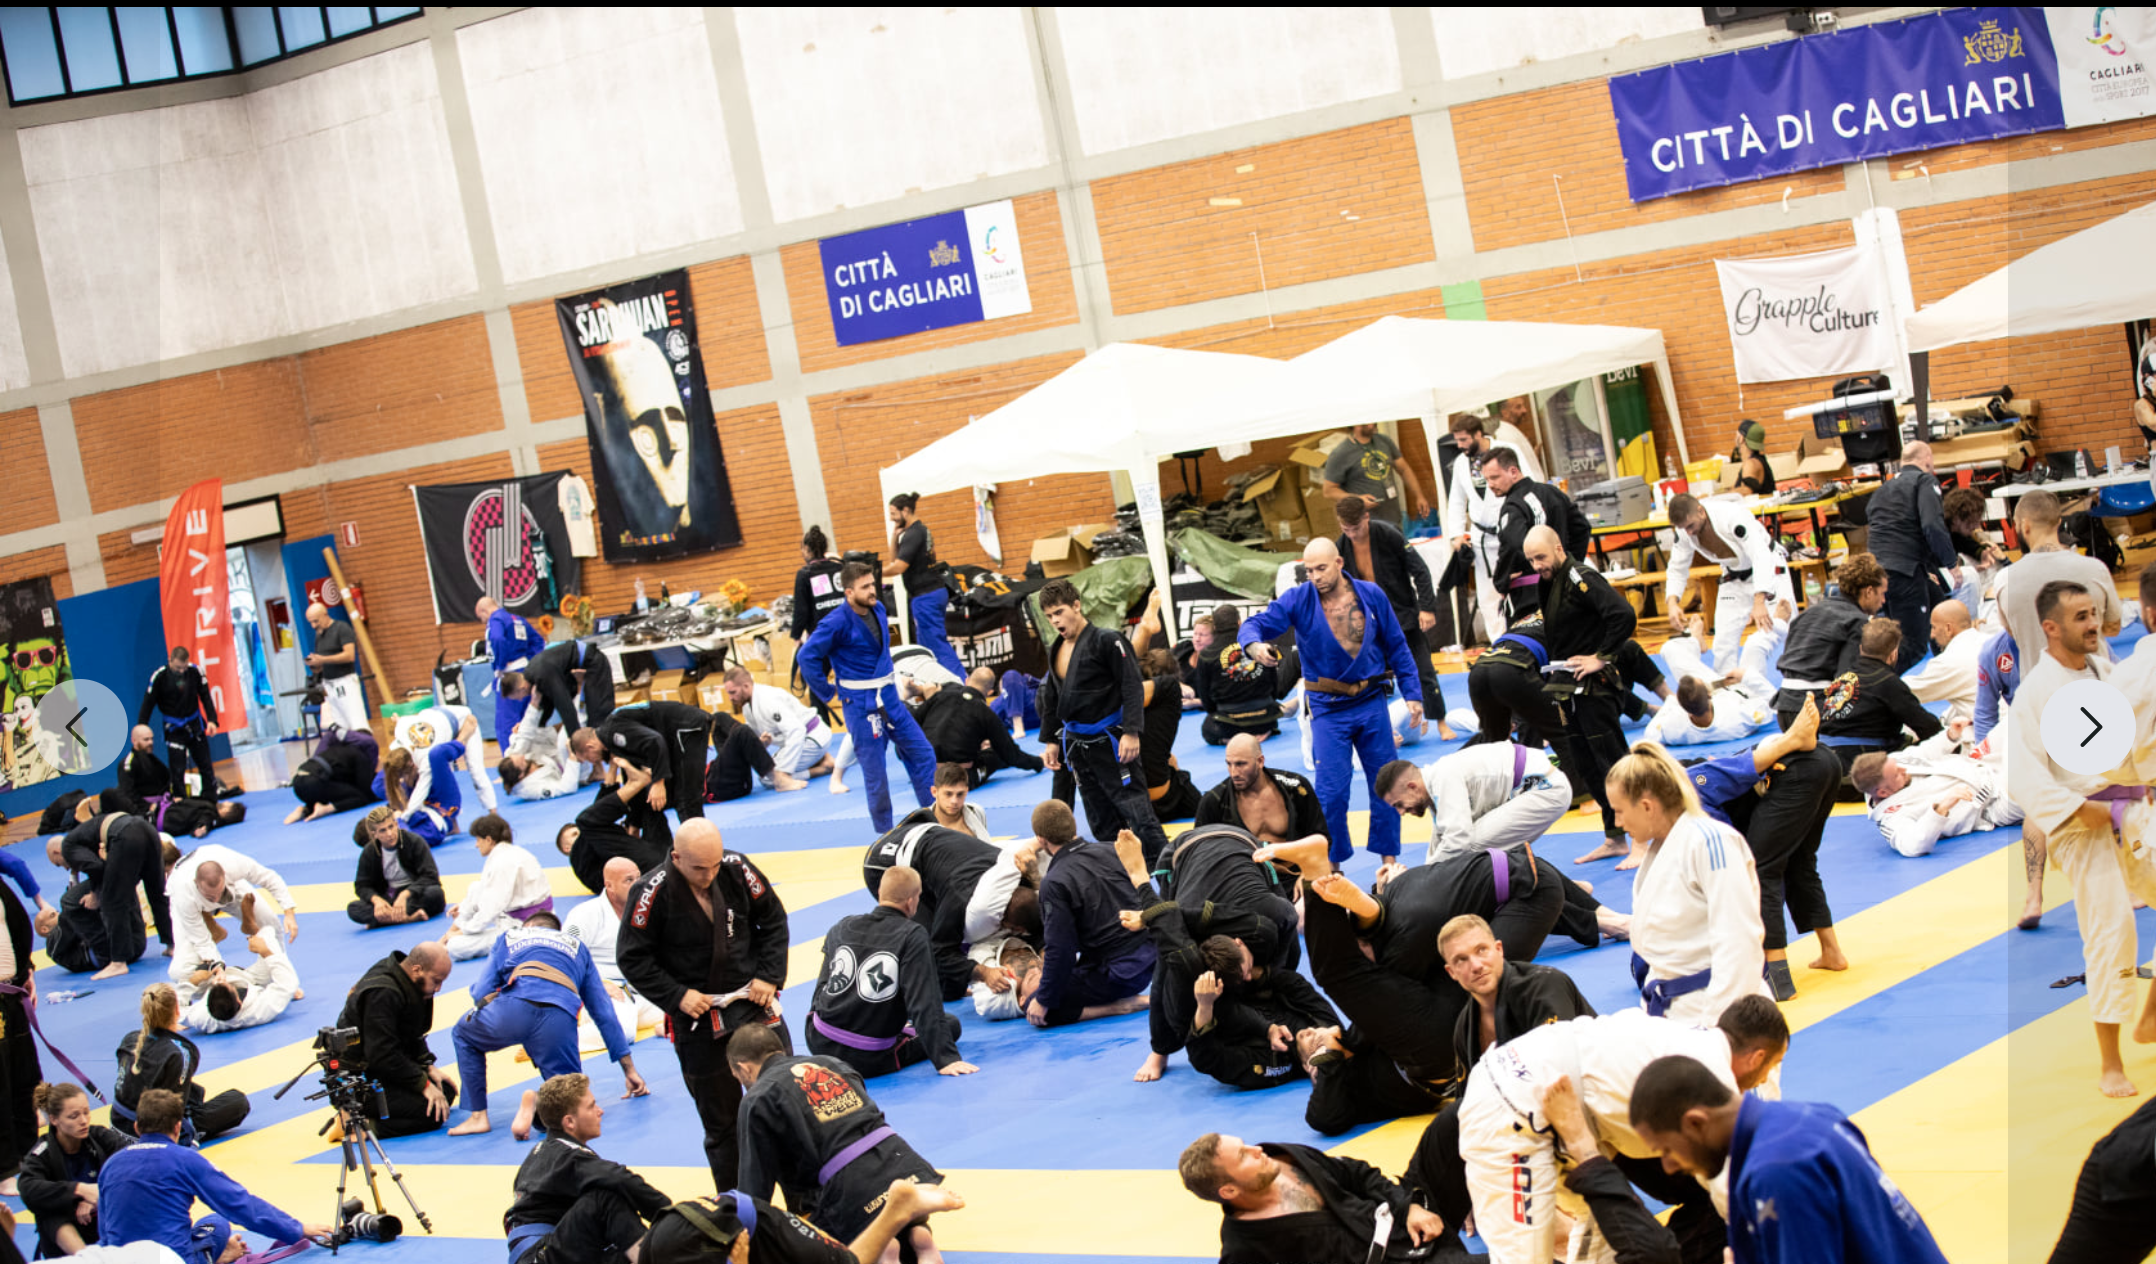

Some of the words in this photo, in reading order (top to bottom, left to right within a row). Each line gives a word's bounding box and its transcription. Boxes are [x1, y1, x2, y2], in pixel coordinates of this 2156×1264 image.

[2090, 63, 2145, 80] CAGLIARI
[2129, 86, 2150, 97] 2017
[1651, 113, 1767, 173] CITTÀ
[1777, 109, 1815, 150] DI
[1831, 72, 2035, 138] CAGLIARI
[834, 250, 899, 288] CITTÀ
[839, 294, 864, 319] DI
[868, 272, 973, 313] CAGLIARI
[1734, 284, 1836, 336] Grapple
[185, 508, 226, 714] STRIVE
[637, 870, 667, 913] VALOR
[509, 937, 577, 960] LUXEMBOURG
